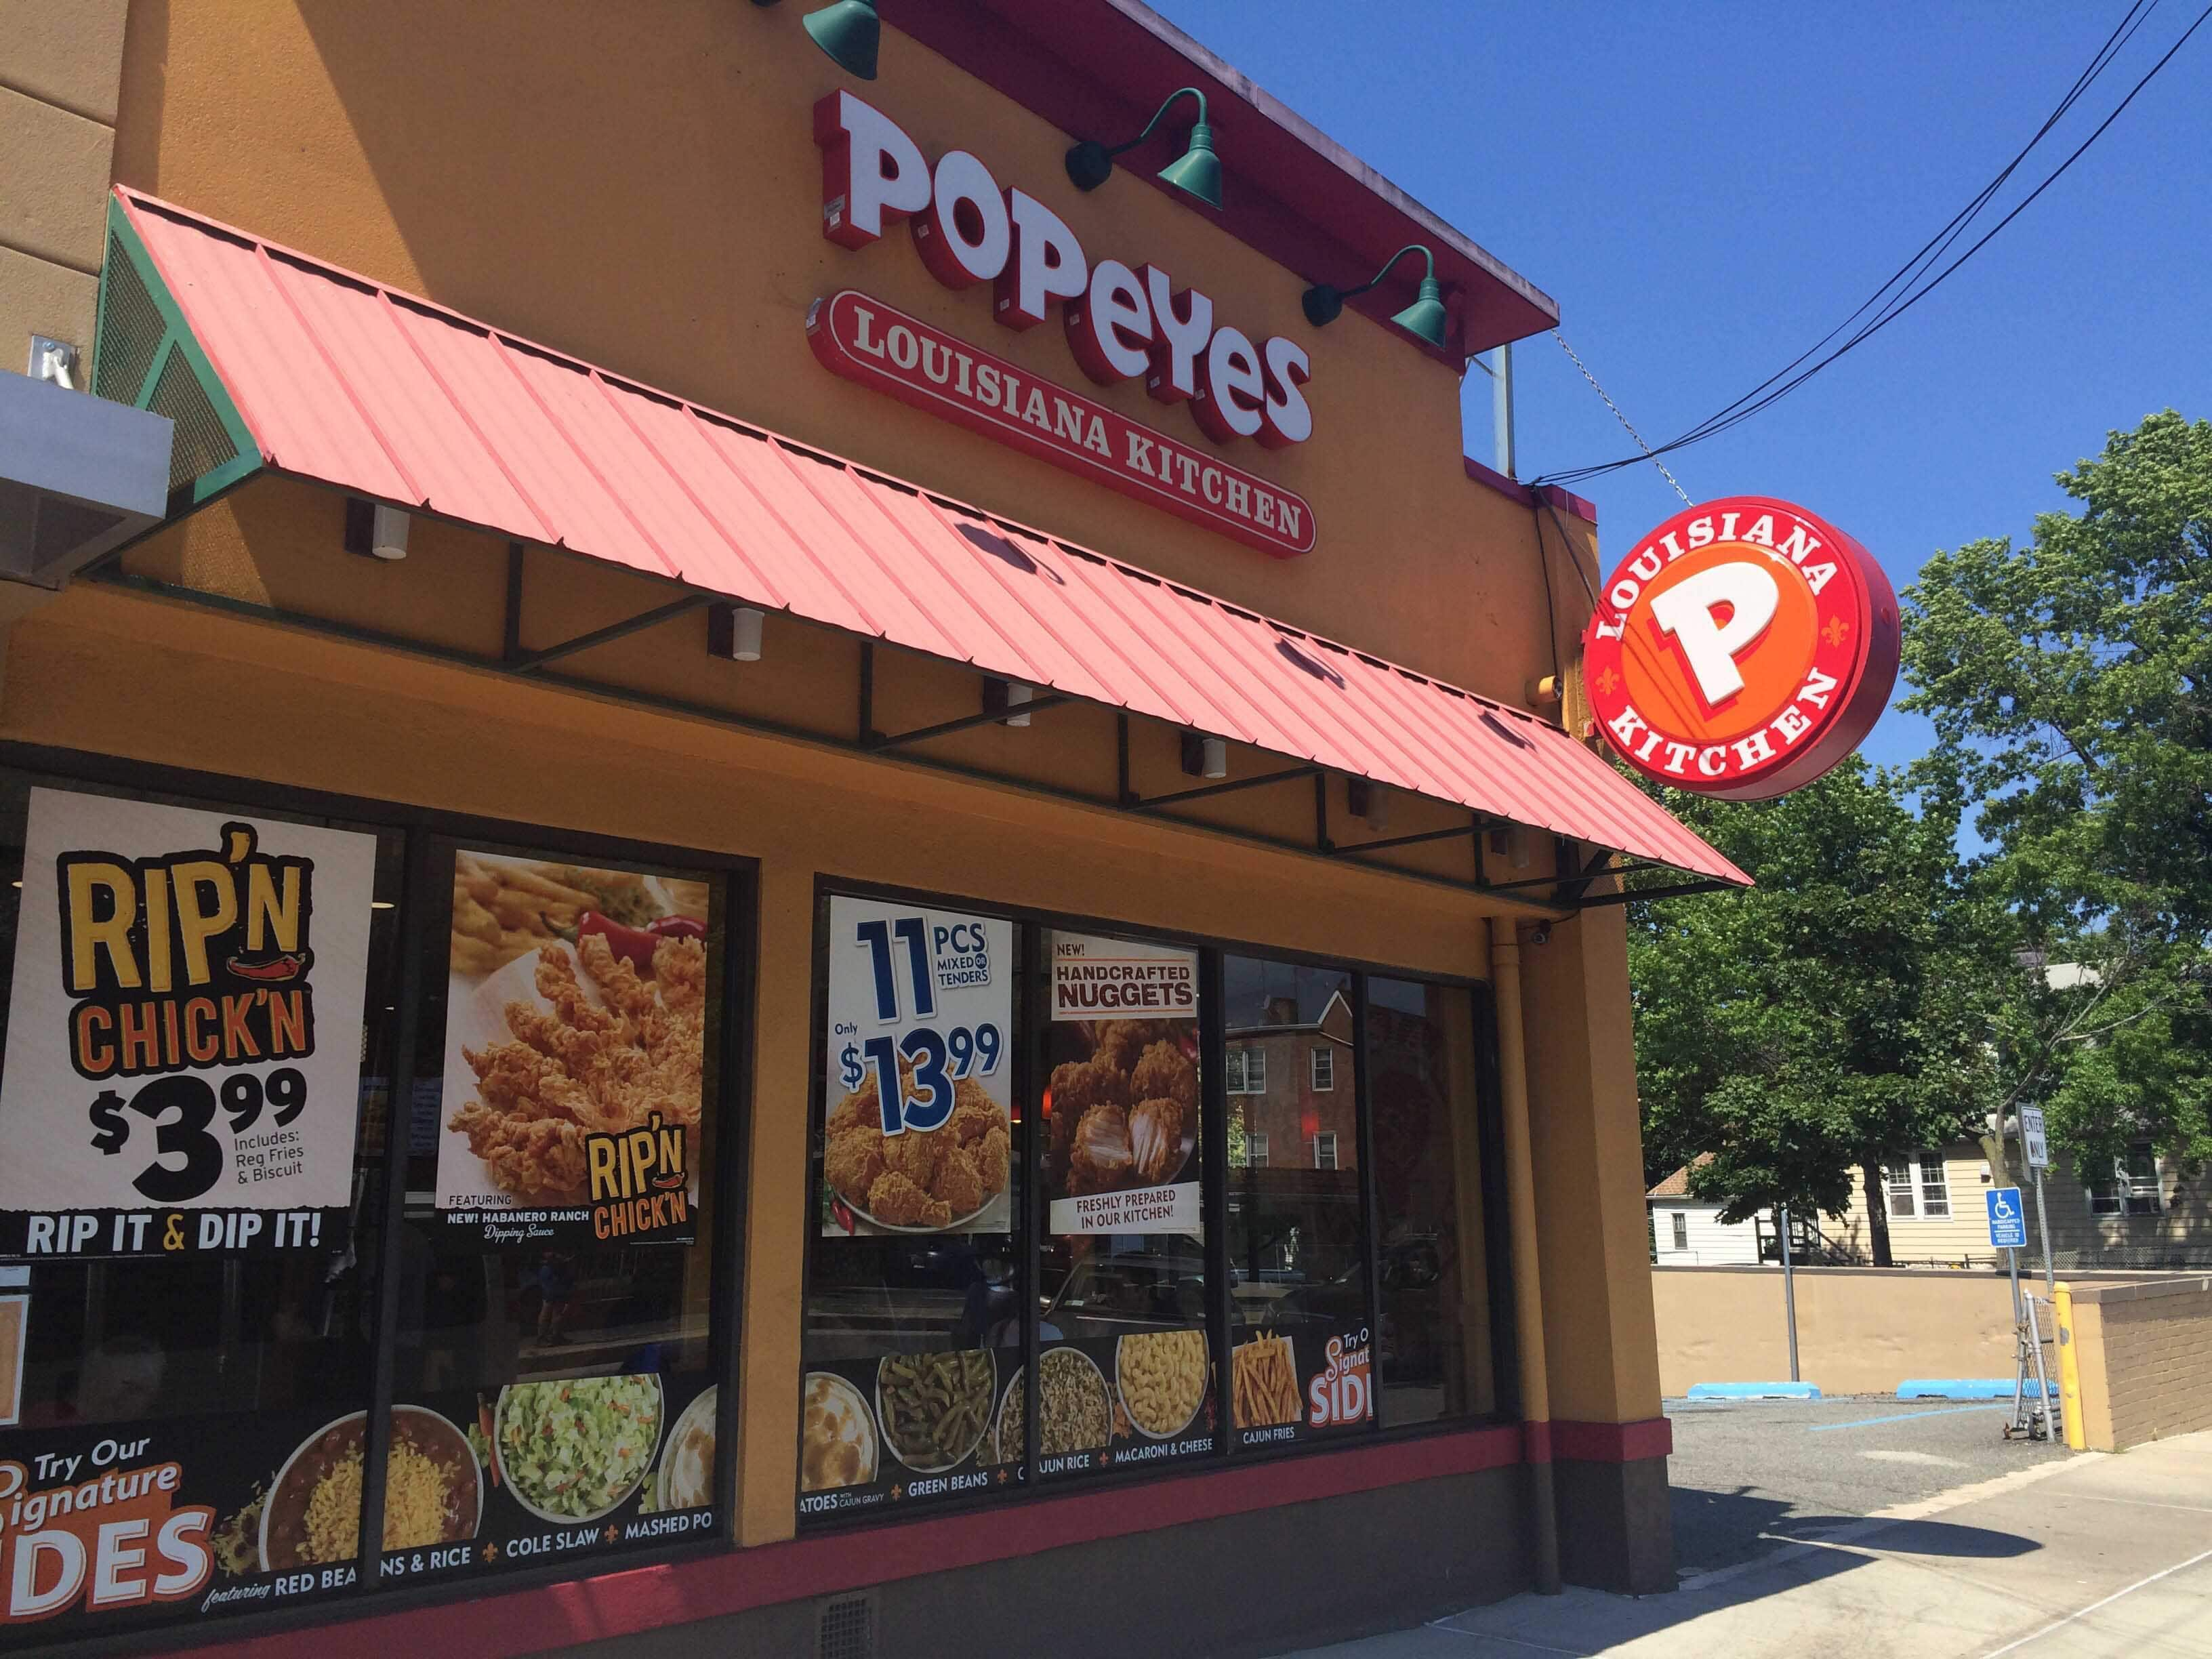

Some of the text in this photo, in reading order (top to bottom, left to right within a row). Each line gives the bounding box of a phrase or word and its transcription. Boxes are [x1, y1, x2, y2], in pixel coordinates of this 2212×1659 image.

[853, 305, 1301, 539] LOUISIANA KITCHEN
[1596, 512, 1838, 641] LOUISIANA
[1650, 562, 1779, 705] P
[1608, 667, 1838, 775] KITCHEN
[66, 832, 300, 992] RIP'N
[1057, 943, 1084, 956] NEW!
[857, 917, 985, 1019] 11 PCS
[938, 957, 974, 970] MIXED
[1057, 965, 1189, 981] HANDCRAFTED
[938, 970, 987, 985] TENDERS
[1058, 982, 1193, 1008] NUGGETS
[77, 989, 306, 1073] CHICK'N
[834, 1023, 858, 1036] Only
[2024, 1115, 2044, 1134] ENTER
[234, 1129, 299, 1151] Includes:
[2030, 1141, 2044, 1158] ONLY
[236, 1145, 304, 1170] Reg Fries
[589, 1115, 681, 1200] RIP'N
[237, 1161, 303, 1185] & Biscuit
[449, 1195, 512, 1206] FEATURING
[1077, 1189, 1175, 1213] FRESHLY PREPARED
[447, 1210, 589, 1224] NEW! HABANERO RANCH
[594, 1191, 687, 1240] CHICK'N
[1081, 1205, 1174, 1229] IN OUR KITCHEN!
[26, 1212, 321, 1254] RIP IT & DIP IT!
[483, 1223, 554, 1244] Dipping Sauce
[1343, 1328, 1369, 1349] Try O
[1326, 1338, 1370, 1381] Signat
[1243, 1427, 1295, 1444] CAJUN FRIES
[35, 1437, 150, 1481] Try Our
[1067, 1454, 1090, 1470] RICE
[1115, 1444, 1168, 1464] MACARONI
[1170, 1443, 1177, 1455] &
[1180, 1439, 1212, 1454] CHEESE
[839, 1497, 861, 1508] CAJUN
[862, 1493, 884, 1503] GRAVY
[908, 1477, 947, 1497] GREEN
[951, 1472, 988, 1490] BEANS
[411, 1555, 424, 1572] &
[430, 1547, 471, 1567] RICE
[506, 1534, 550, 1557] COLE
[556, 1528, 600, 1550] SLAW
[625, 1515, 689, 1540] MASHED
[0, 1512, 207, 1616] DES
[201, 1583, 271, 1612] featuring
[274, 1574, 314, 1596] RED
